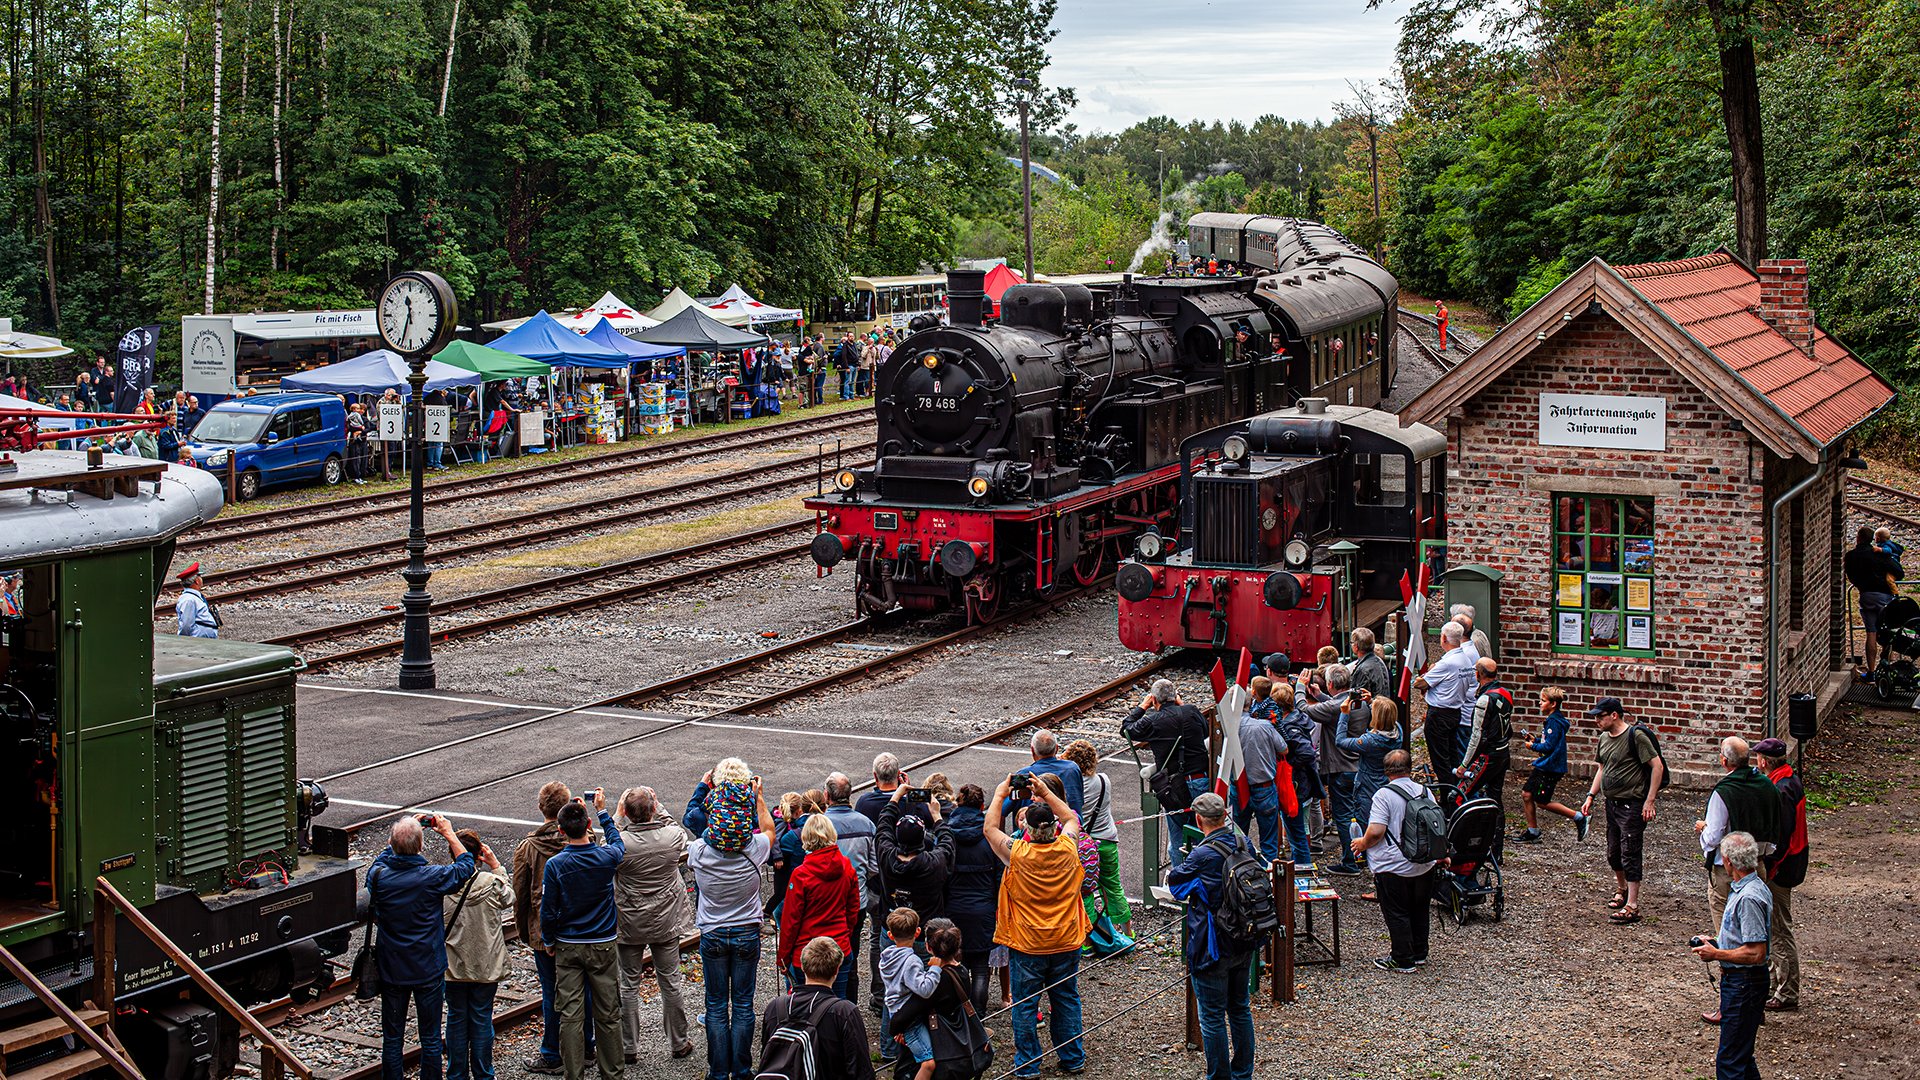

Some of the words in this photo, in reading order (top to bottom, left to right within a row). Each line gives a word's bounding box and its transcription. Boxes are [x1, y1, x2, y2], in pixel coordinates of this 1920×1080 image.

[315, 315, 326, 323] Fit
[327, 315, 341, 323] mit
[342, 314, 362, 322] Fisch
[918, 397, 932, 408] 78
[935, 398, 956, 409] 468
[381, 408, 400, 416] GLEIS
[427, 409, 446, 417] GLEIS
[1549, 404, 1657, 421] Fahrkartenausgabe
[387, 421, 395, 434] 3
[433, 422, 440, 436] 2
[1566, 422, 1637, 435] Information
[212, 944, 220, 954] TS
[124, 972, 139, 982] Knorr
